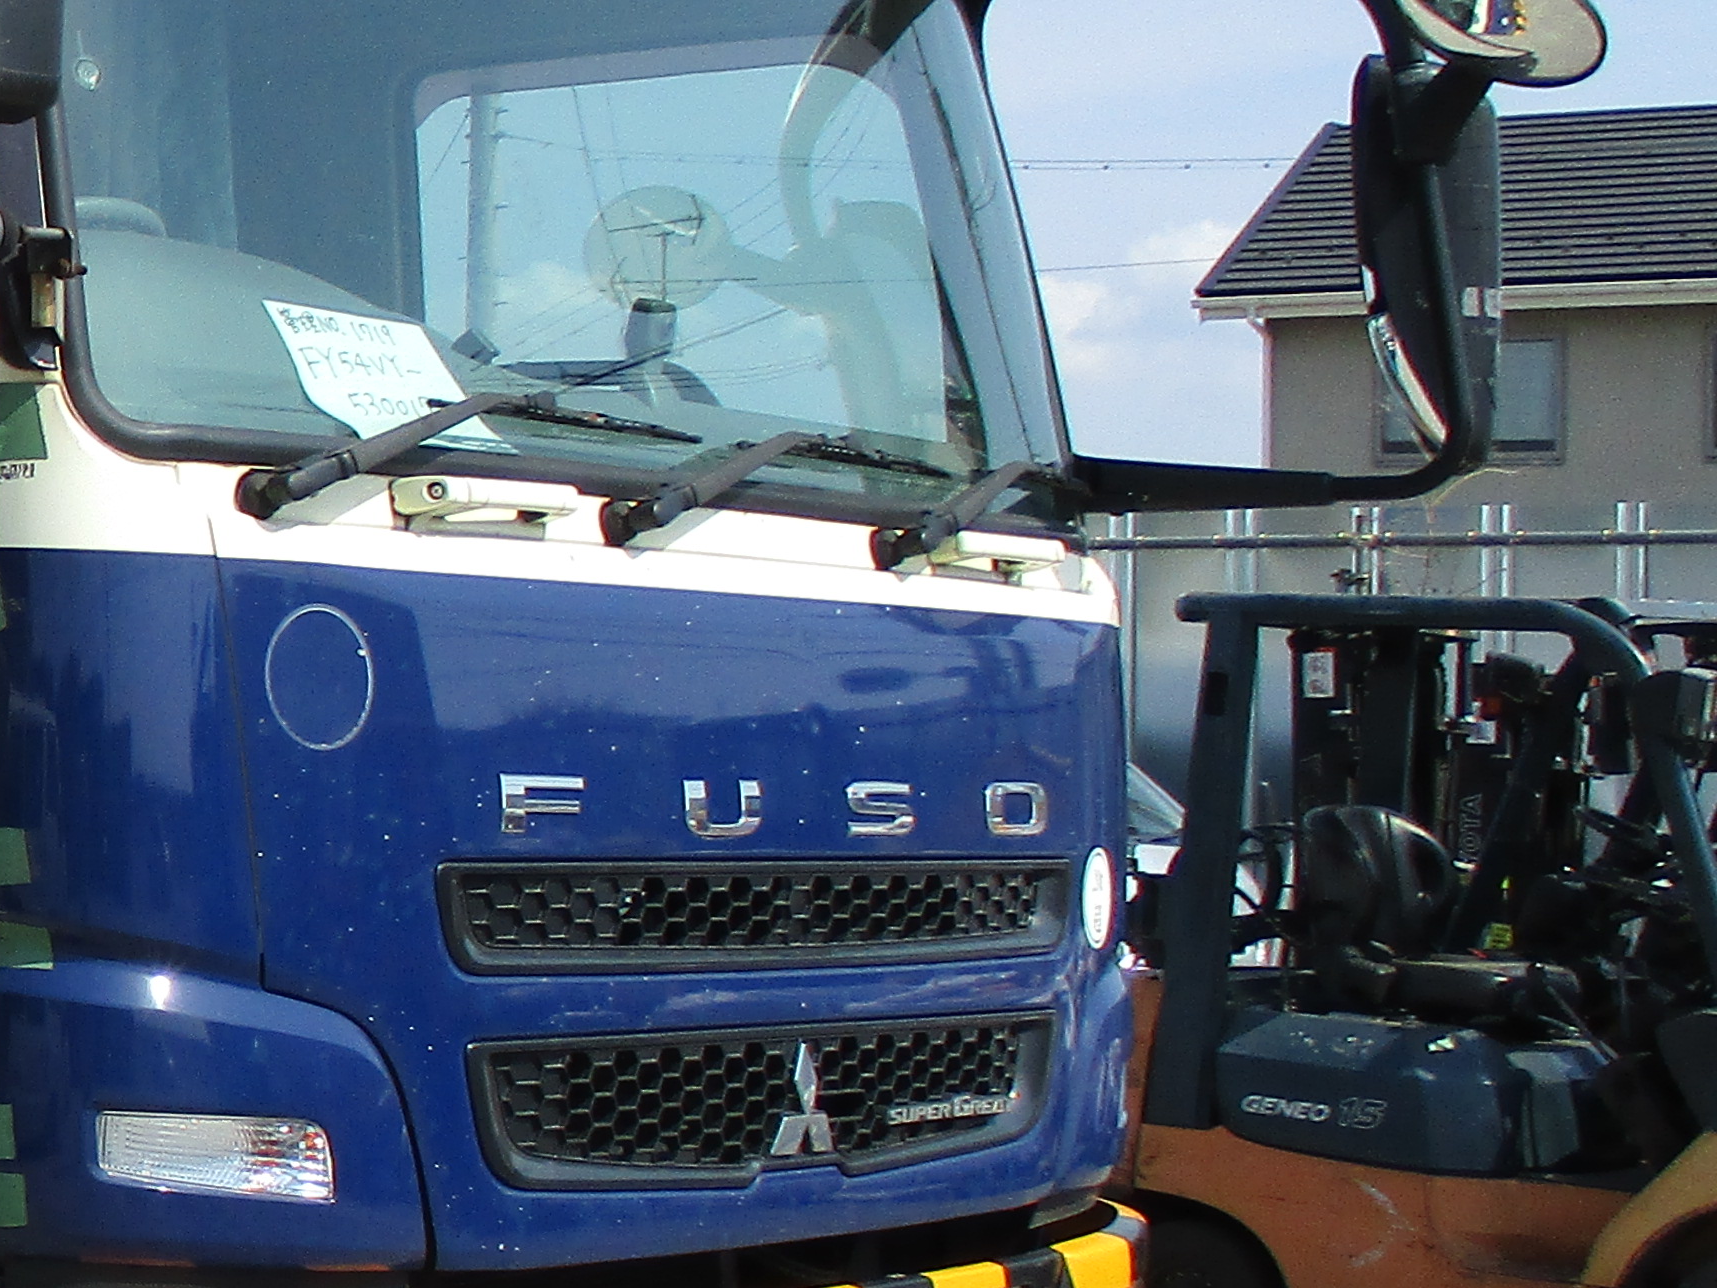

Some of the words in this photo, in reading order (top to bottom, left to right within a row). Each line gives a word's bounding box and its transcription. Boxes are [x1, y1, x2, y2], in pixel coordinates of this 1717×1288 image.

[349, 320, 397, 347] 1719
[497, 772, 1051, 838] FUSO
[1240, 1093, 1334, 1123] GENEO
[1336, 1096, 1389, 1130] 15
